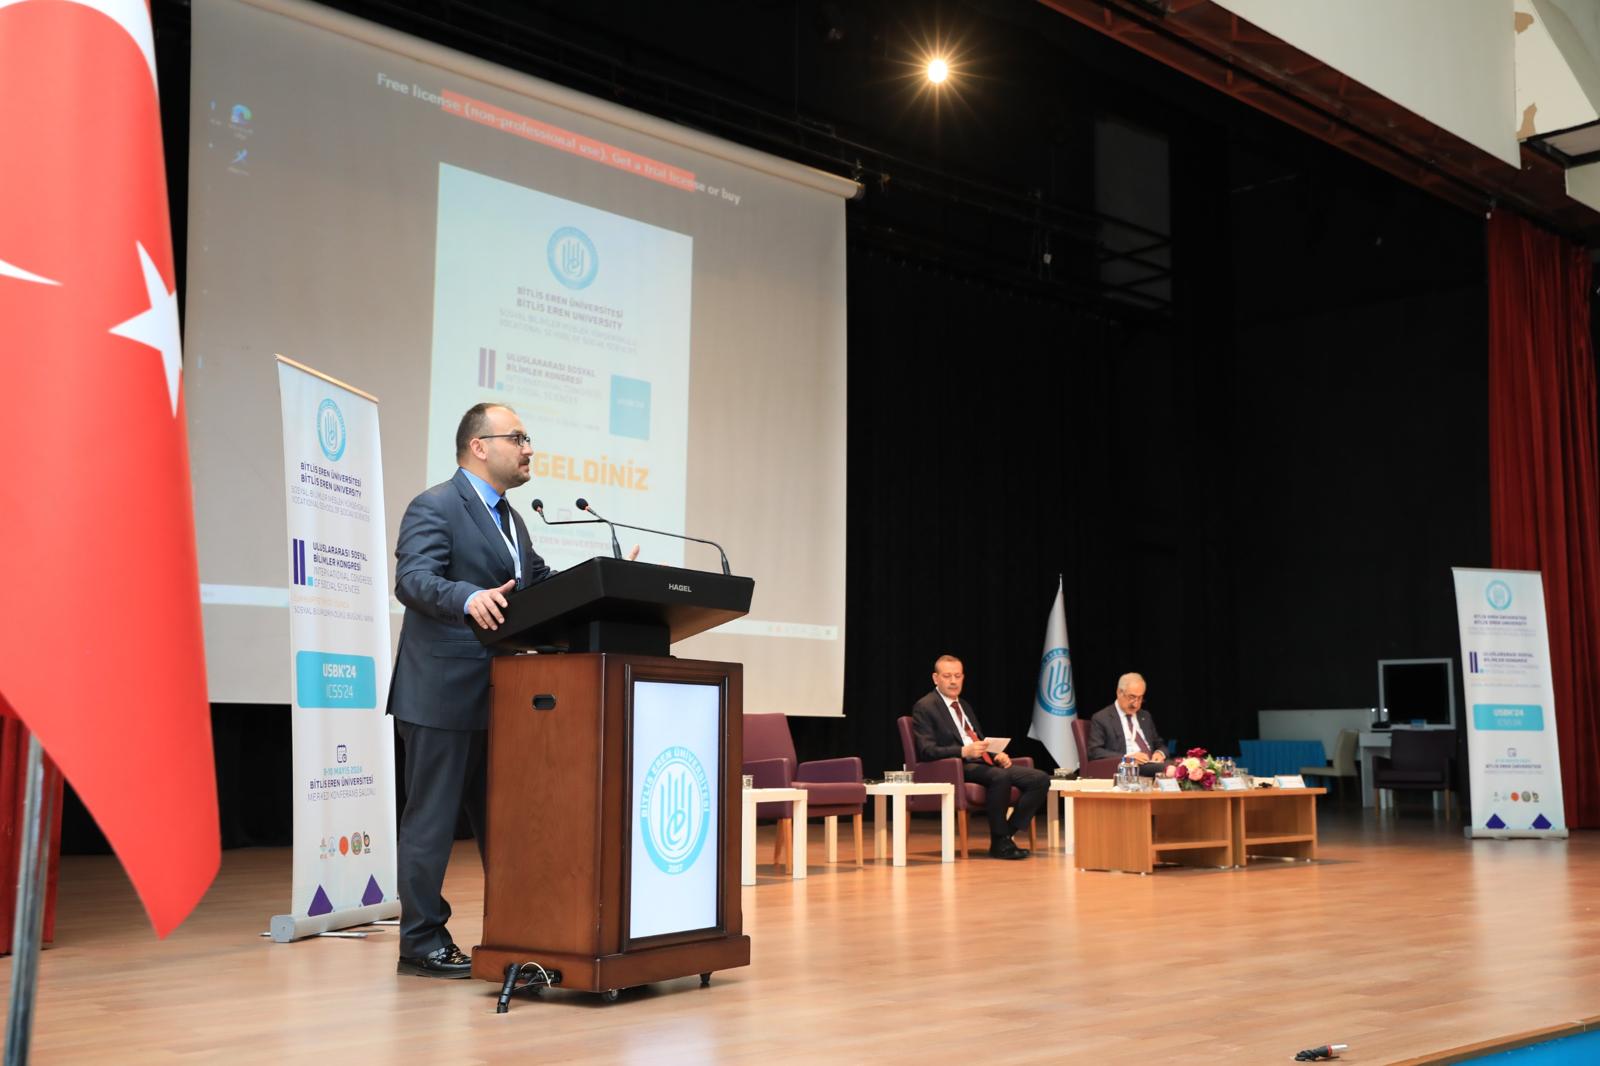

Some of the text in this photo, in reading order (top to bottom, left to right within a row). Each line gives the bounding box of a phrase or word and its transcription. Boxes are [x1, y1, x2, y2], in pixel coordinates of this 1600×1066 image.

[377, 72, 409, 95] Free
[413, 84, 461, 112] license
[464, 102, 576, 148] (non-professional
[612, 152, 632, 167] Get
[645, 163, 667, 178] trial
[670, 170, 705, 192] license
[707, 185, 721, 196] or
[722, 187, 741, 205] buy
[545, 293, 568, 305] EREN
[547, 305, 571, 318] EREN
[300, 461, 362, 488] BİTLİS EREN ÜNİVERSİTESİ
[534, 451, 649, 491] GELDİNİZ
[300, 473, 362, 499] BİTLİS EREN UNIVERSITY
[313, 541, 368, 562] ULUSLARARASI SOSYAL
[313, 553, 361, 571] BİLİMLER KONGRESİ
[668, 583, 693, 593] HAGEL
[322, 663, 357, 679] USBK'24
[310, 774, 374, 790] BİTLİS EREN ÜNİVERSİTESİ
